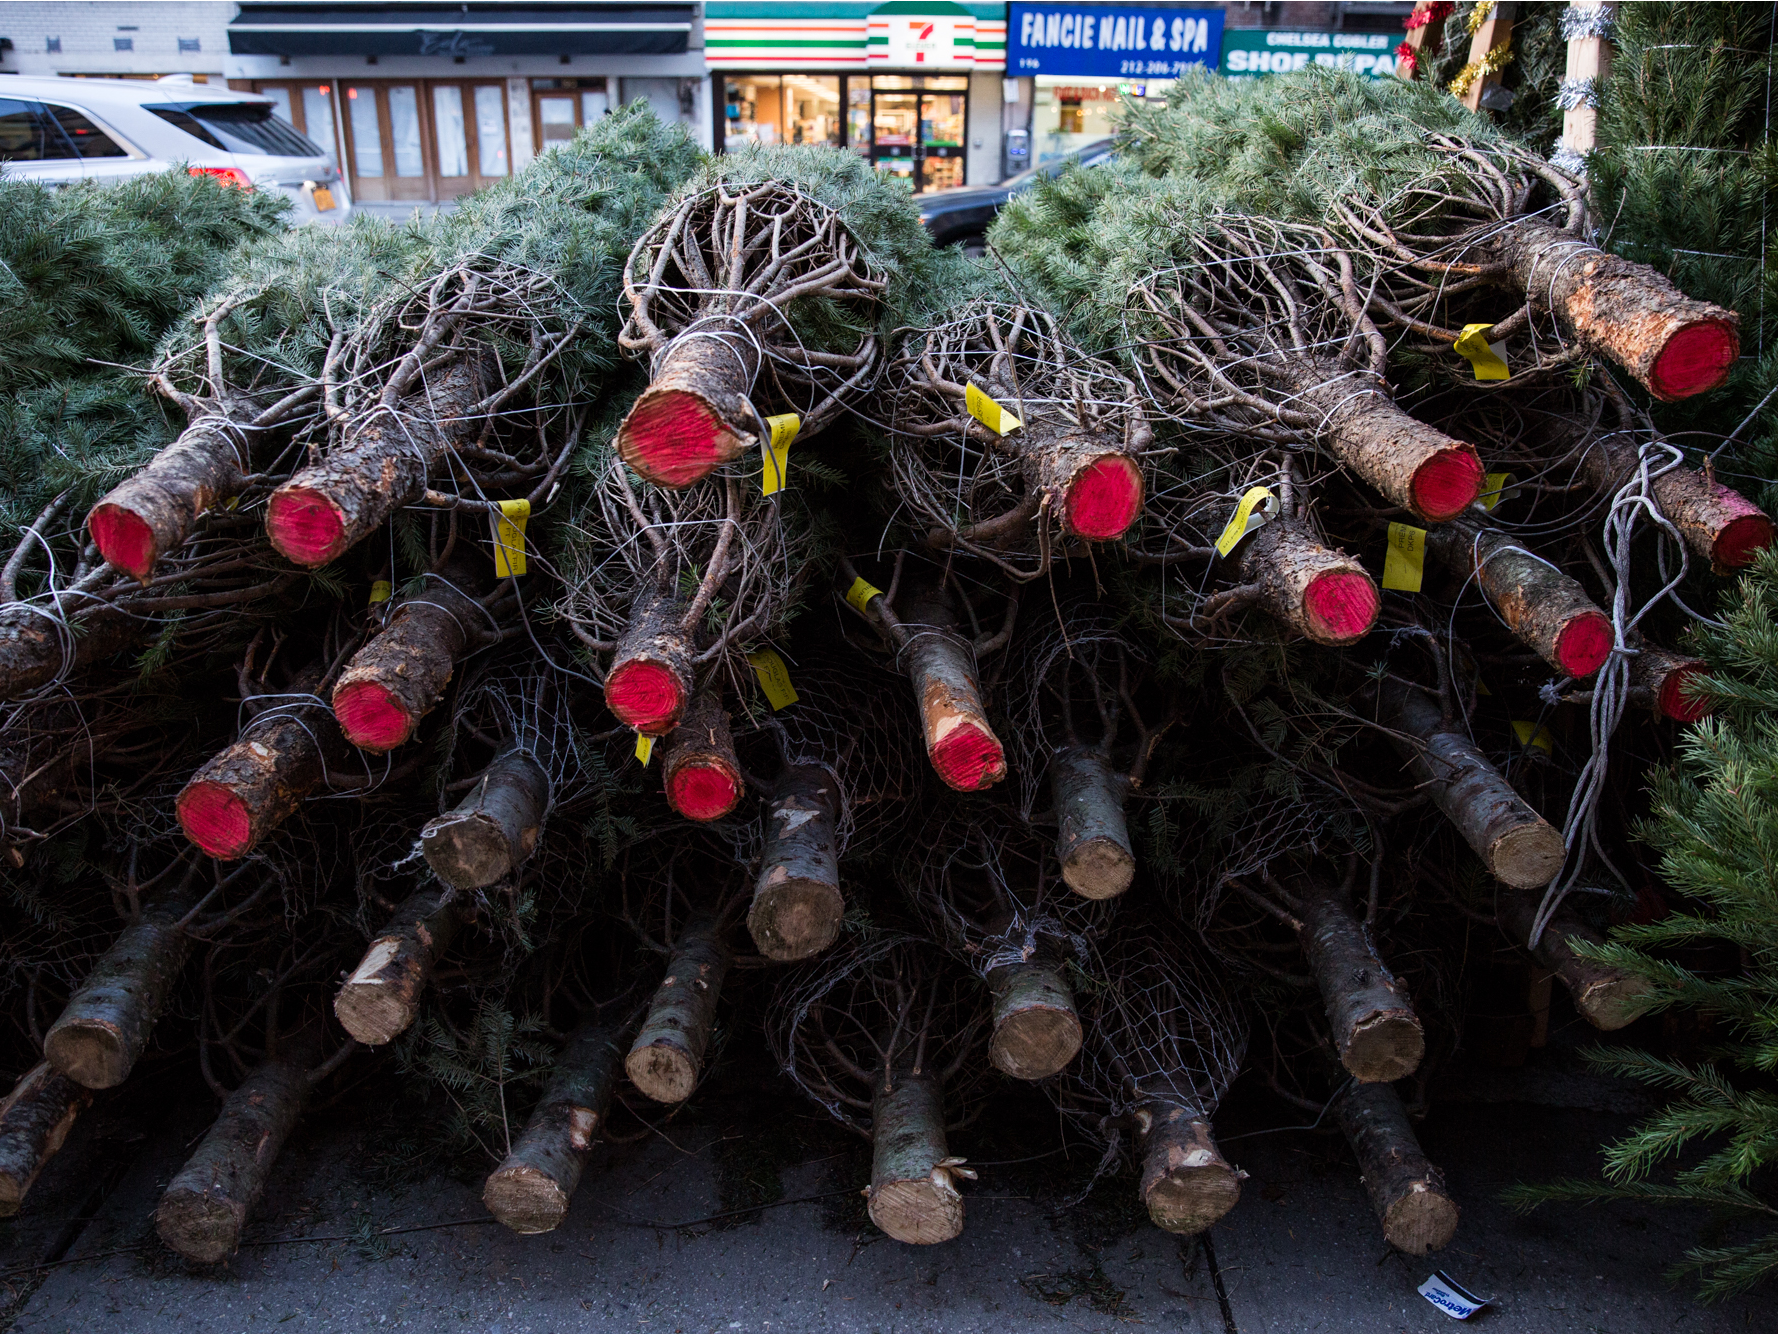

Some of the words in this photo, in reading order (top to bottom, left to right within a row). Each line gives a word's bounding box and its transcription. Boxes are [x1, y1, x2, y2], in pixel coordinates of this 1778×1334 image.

[909, 22, 934, 62] 7
[1020, 12, 1095, 49] FANCIE
[1098, 15, 1147, 51] NAIL
[1150, 17, 1166, 51] &
[1169, 17, 1208, 53] SPA
[1266, 32, 1330, 47] CHELSEA
[1424, 1291, 1473, 1316] MetroCard
